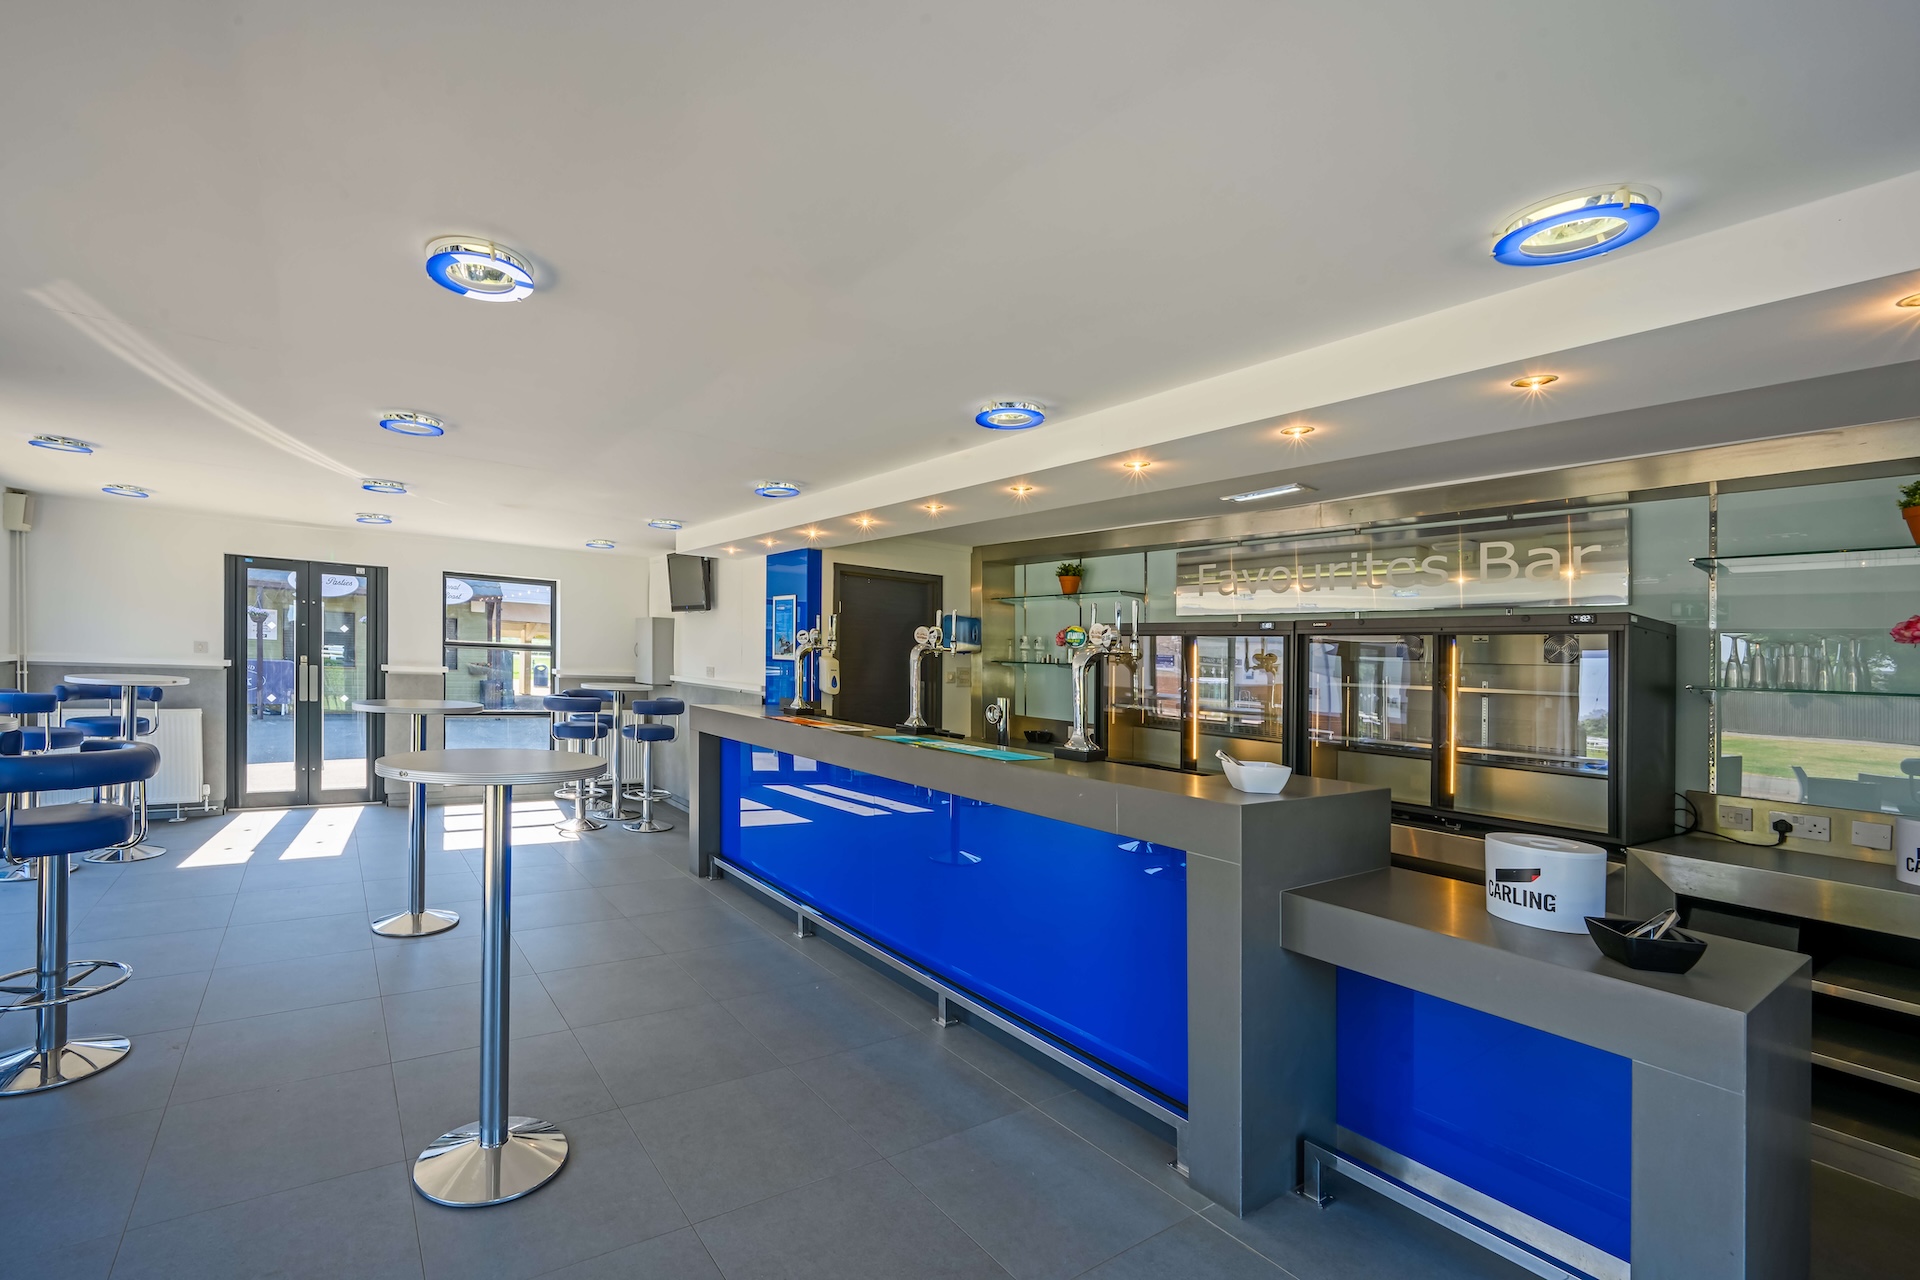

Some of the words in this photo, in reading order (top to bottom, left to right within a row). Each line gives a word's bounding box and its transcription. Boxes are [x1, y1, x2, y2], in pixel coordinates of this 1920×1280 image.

[326, 576, 353, 587] Pasties
[1197, 552, 1449, 597] Favourites
[1479, 541, 1602, 585] Bar
[1488, 879, 1557, 913] CARLING
